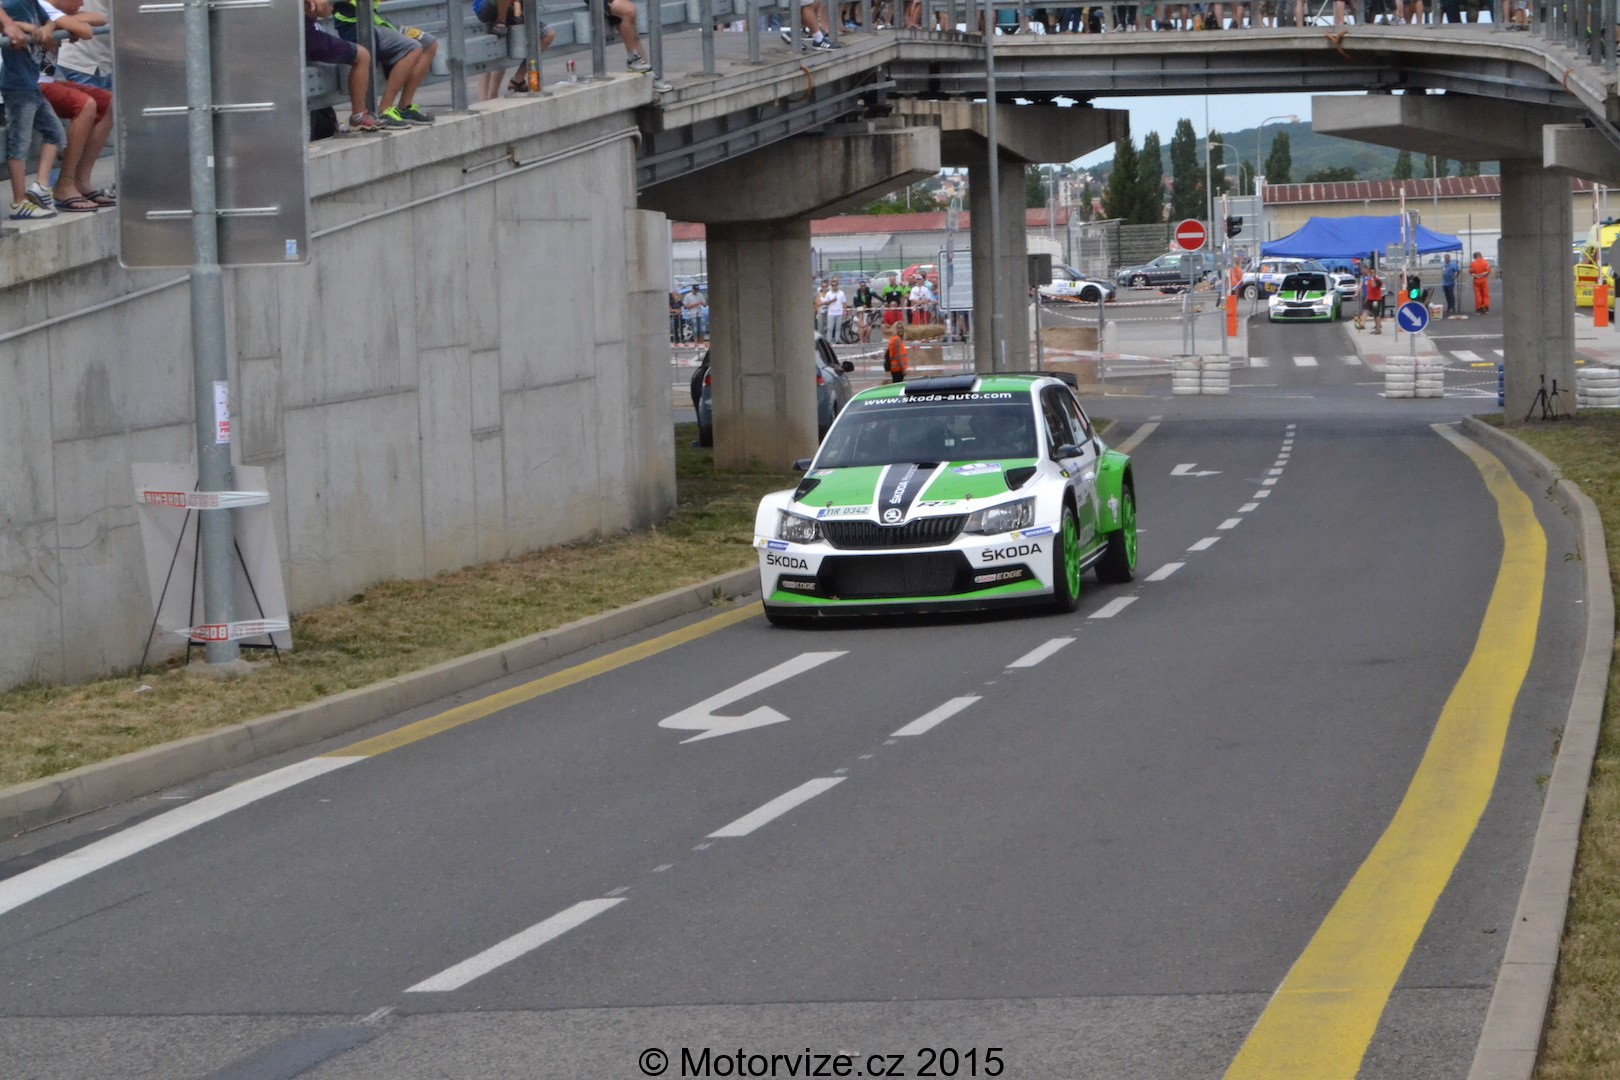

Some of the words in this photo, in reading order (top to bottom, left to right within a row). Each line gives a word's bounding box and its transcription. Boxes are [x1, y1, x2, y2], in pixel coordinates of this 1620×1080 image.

[864, 392, 1012, 406] www.skoda-auto.com
[843, 507, 868, 515] 0342
[982, 543, 1042, 562] ŠKODA
[766, 552, 808, 570] ŠKODA
[996, 569, 1023, 580] EDGE
[795, 582, 816, 590] EDGE
